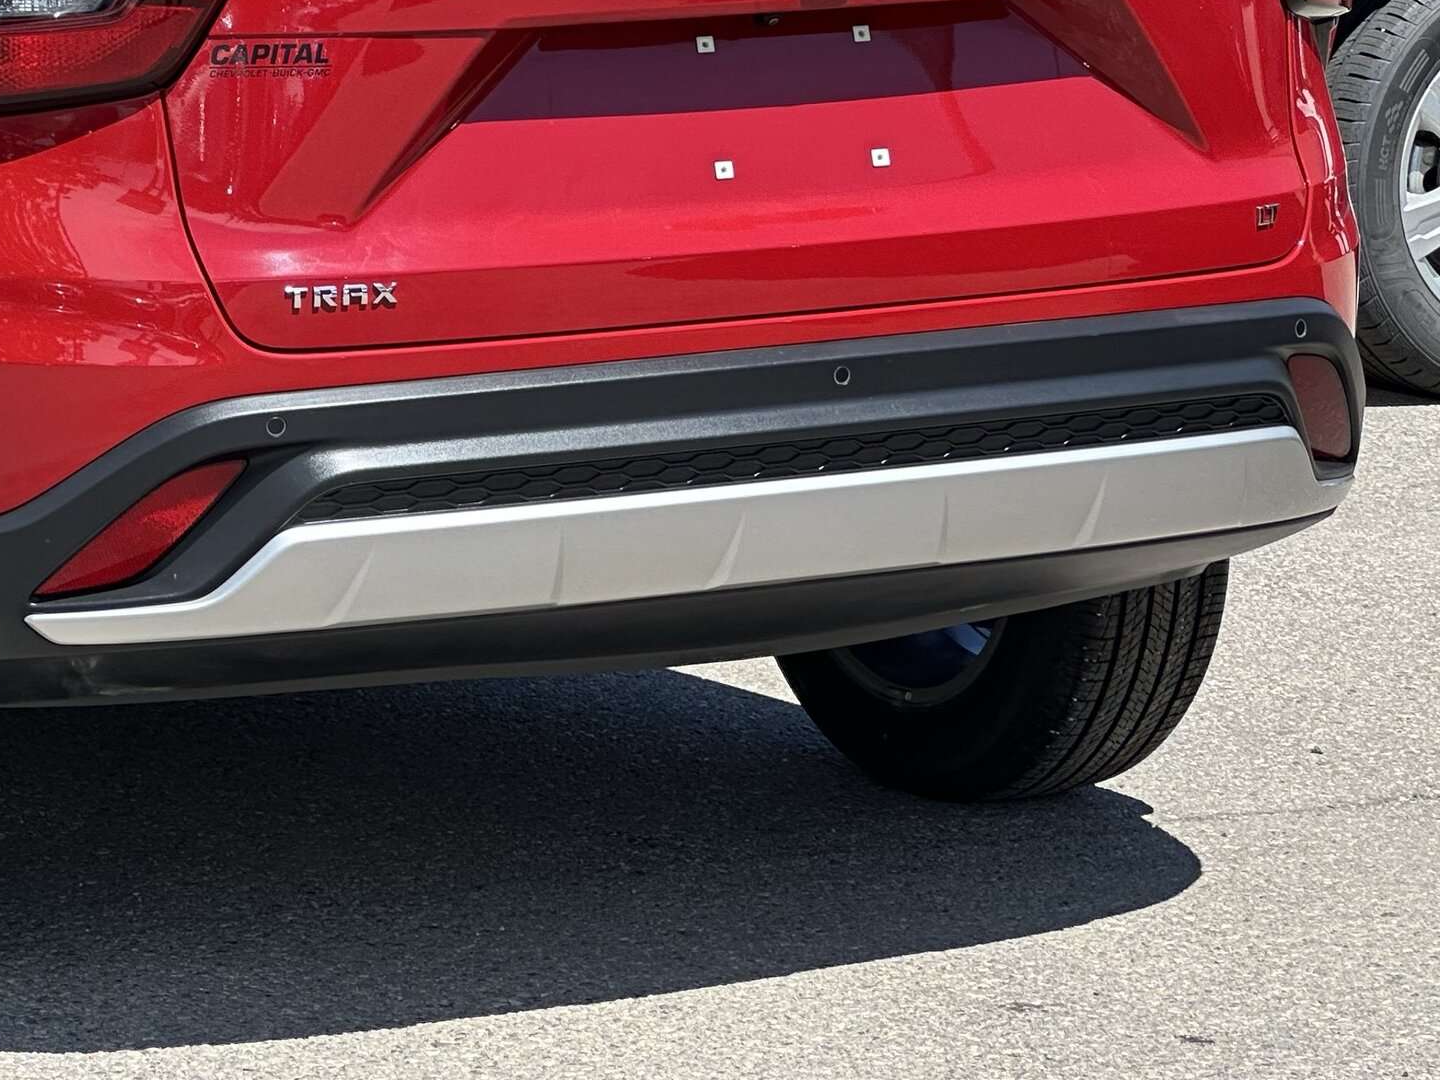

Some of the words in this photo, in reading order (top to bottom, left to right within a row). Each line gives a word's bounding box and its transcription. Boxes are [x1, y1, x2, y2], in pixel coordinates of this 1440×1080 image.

[210, 43, 329, 66] CAPITAL
[1255, 202, 1280, 232] LT
[284, 281, 398, 313] TRAX
